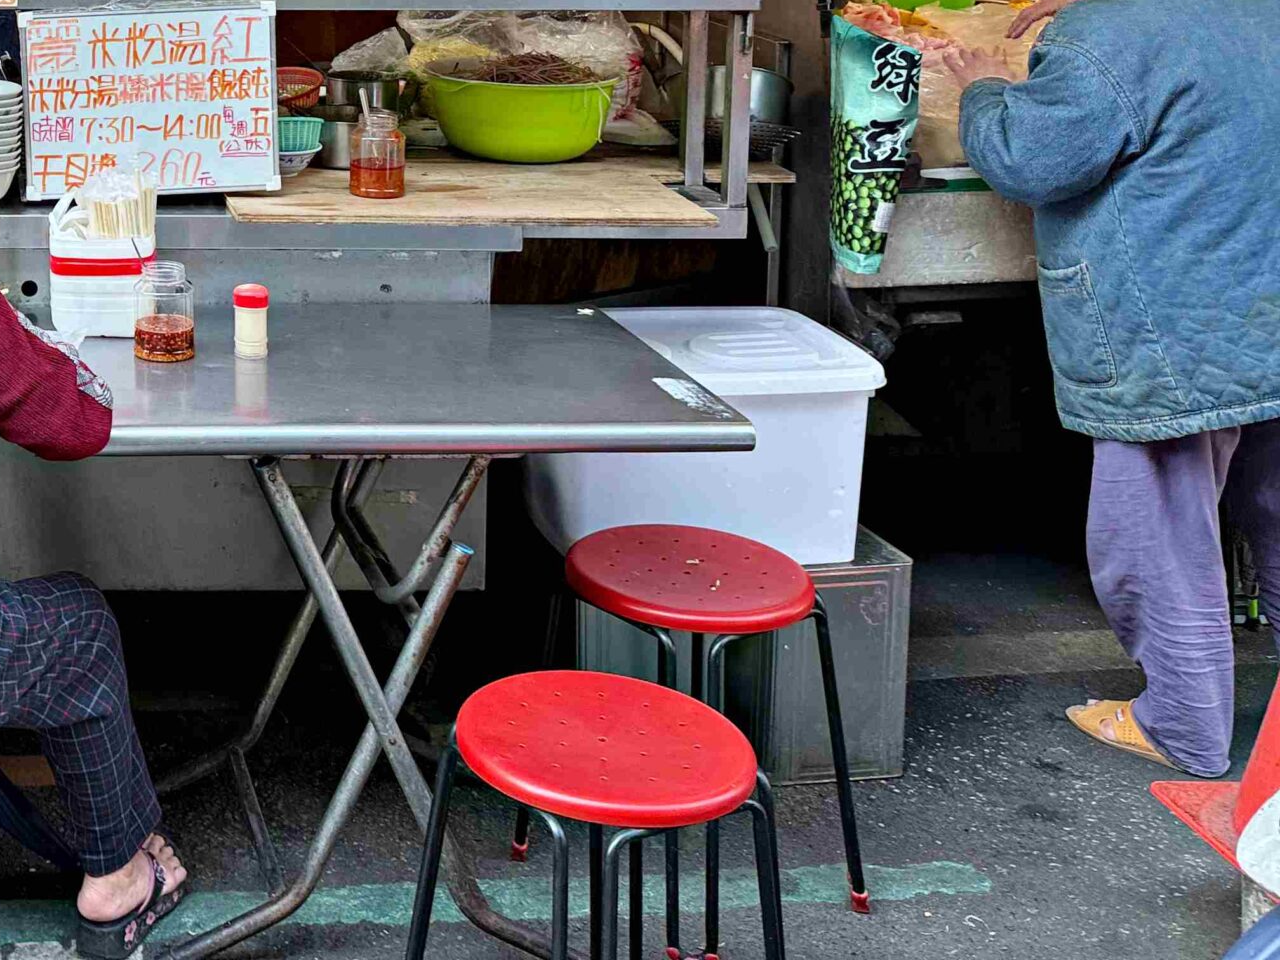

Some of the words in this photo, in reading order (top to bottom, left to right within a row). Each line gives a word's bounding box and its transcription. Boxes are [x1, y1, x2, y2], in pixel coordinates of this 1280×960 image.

[88, 21, 206, 70] 米粉湯
[32, 115, 74, 143] 時間
